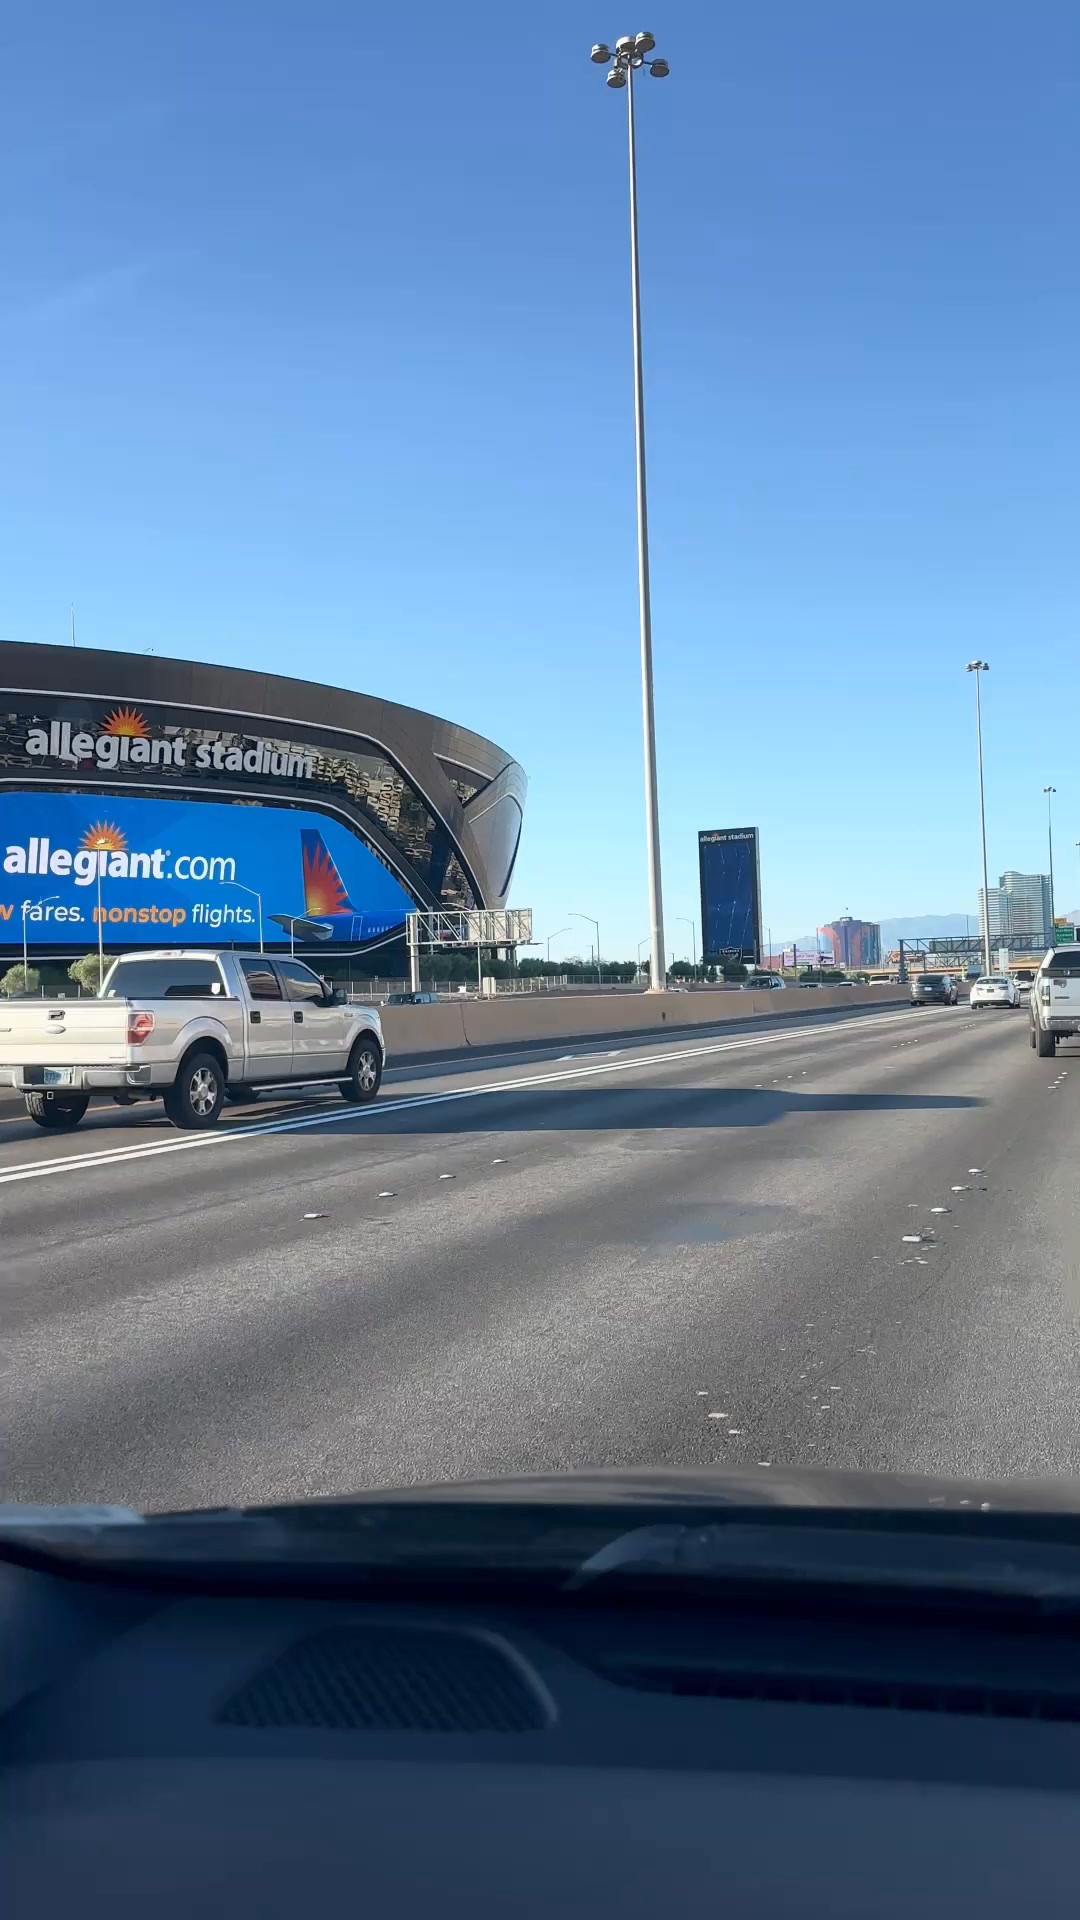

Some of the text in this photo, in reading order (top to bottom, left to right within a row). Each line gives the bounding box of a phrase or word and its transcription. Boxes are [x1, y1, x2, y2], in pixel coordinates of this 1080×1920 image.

[25, 720, 313, 779] allegiant stadium
[700, 834, 727, 842] allegiant
[21, 900, 85, 922] fares.
[92, 905, 186, 928] nonstop
[192, 904, 256, 928] flights.
